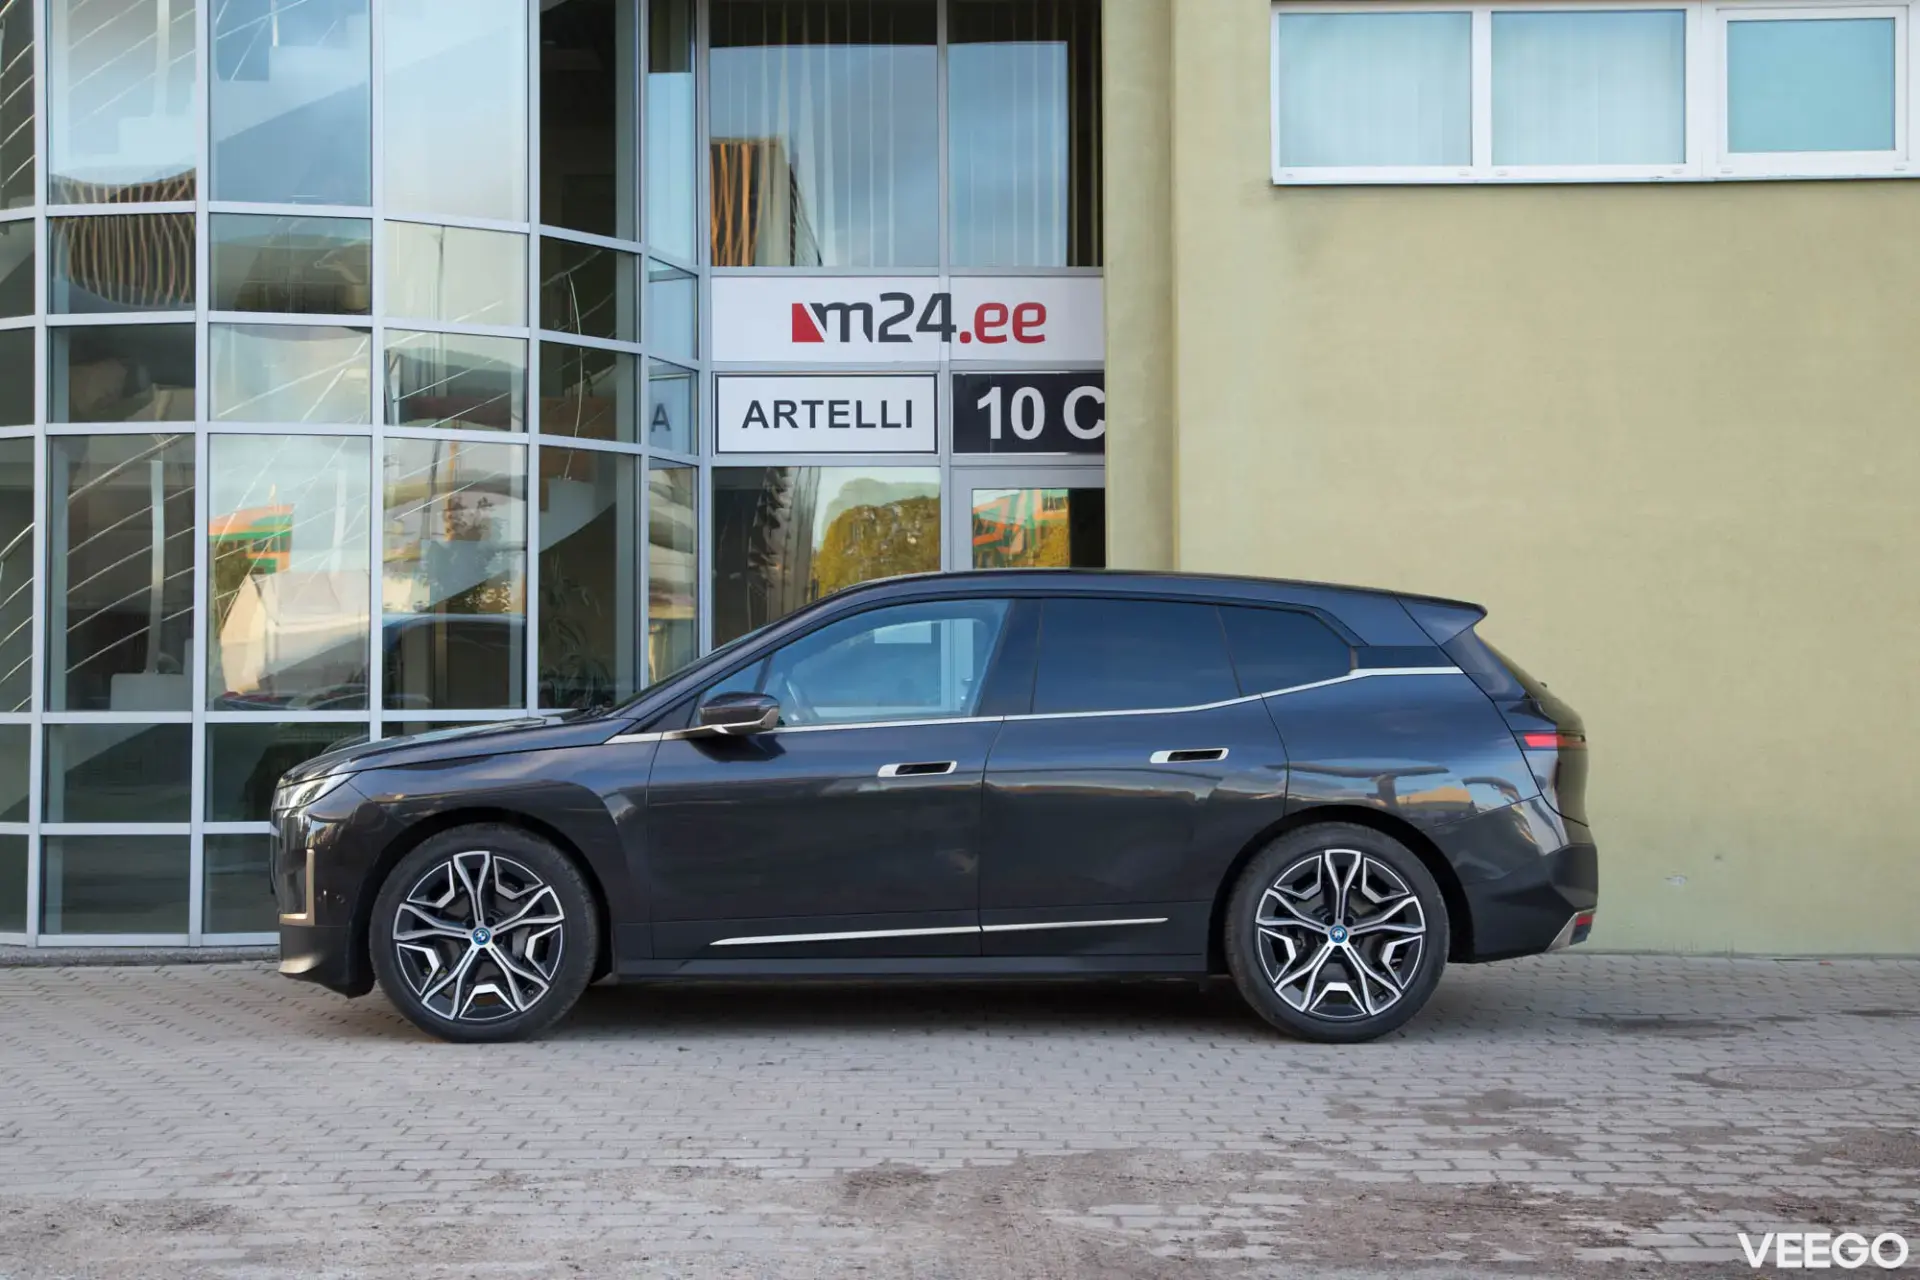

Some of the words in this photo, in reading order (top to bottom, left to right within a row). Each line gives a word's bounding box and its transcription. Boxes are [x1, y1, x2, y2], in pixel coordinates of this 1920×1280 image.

[808, 291, 1047, 345] m24.ee
[741, 399, 913, 429] ARTELLI
[976, 386, 1046, 440] 10
[1063, 385, 1106, 440] C
